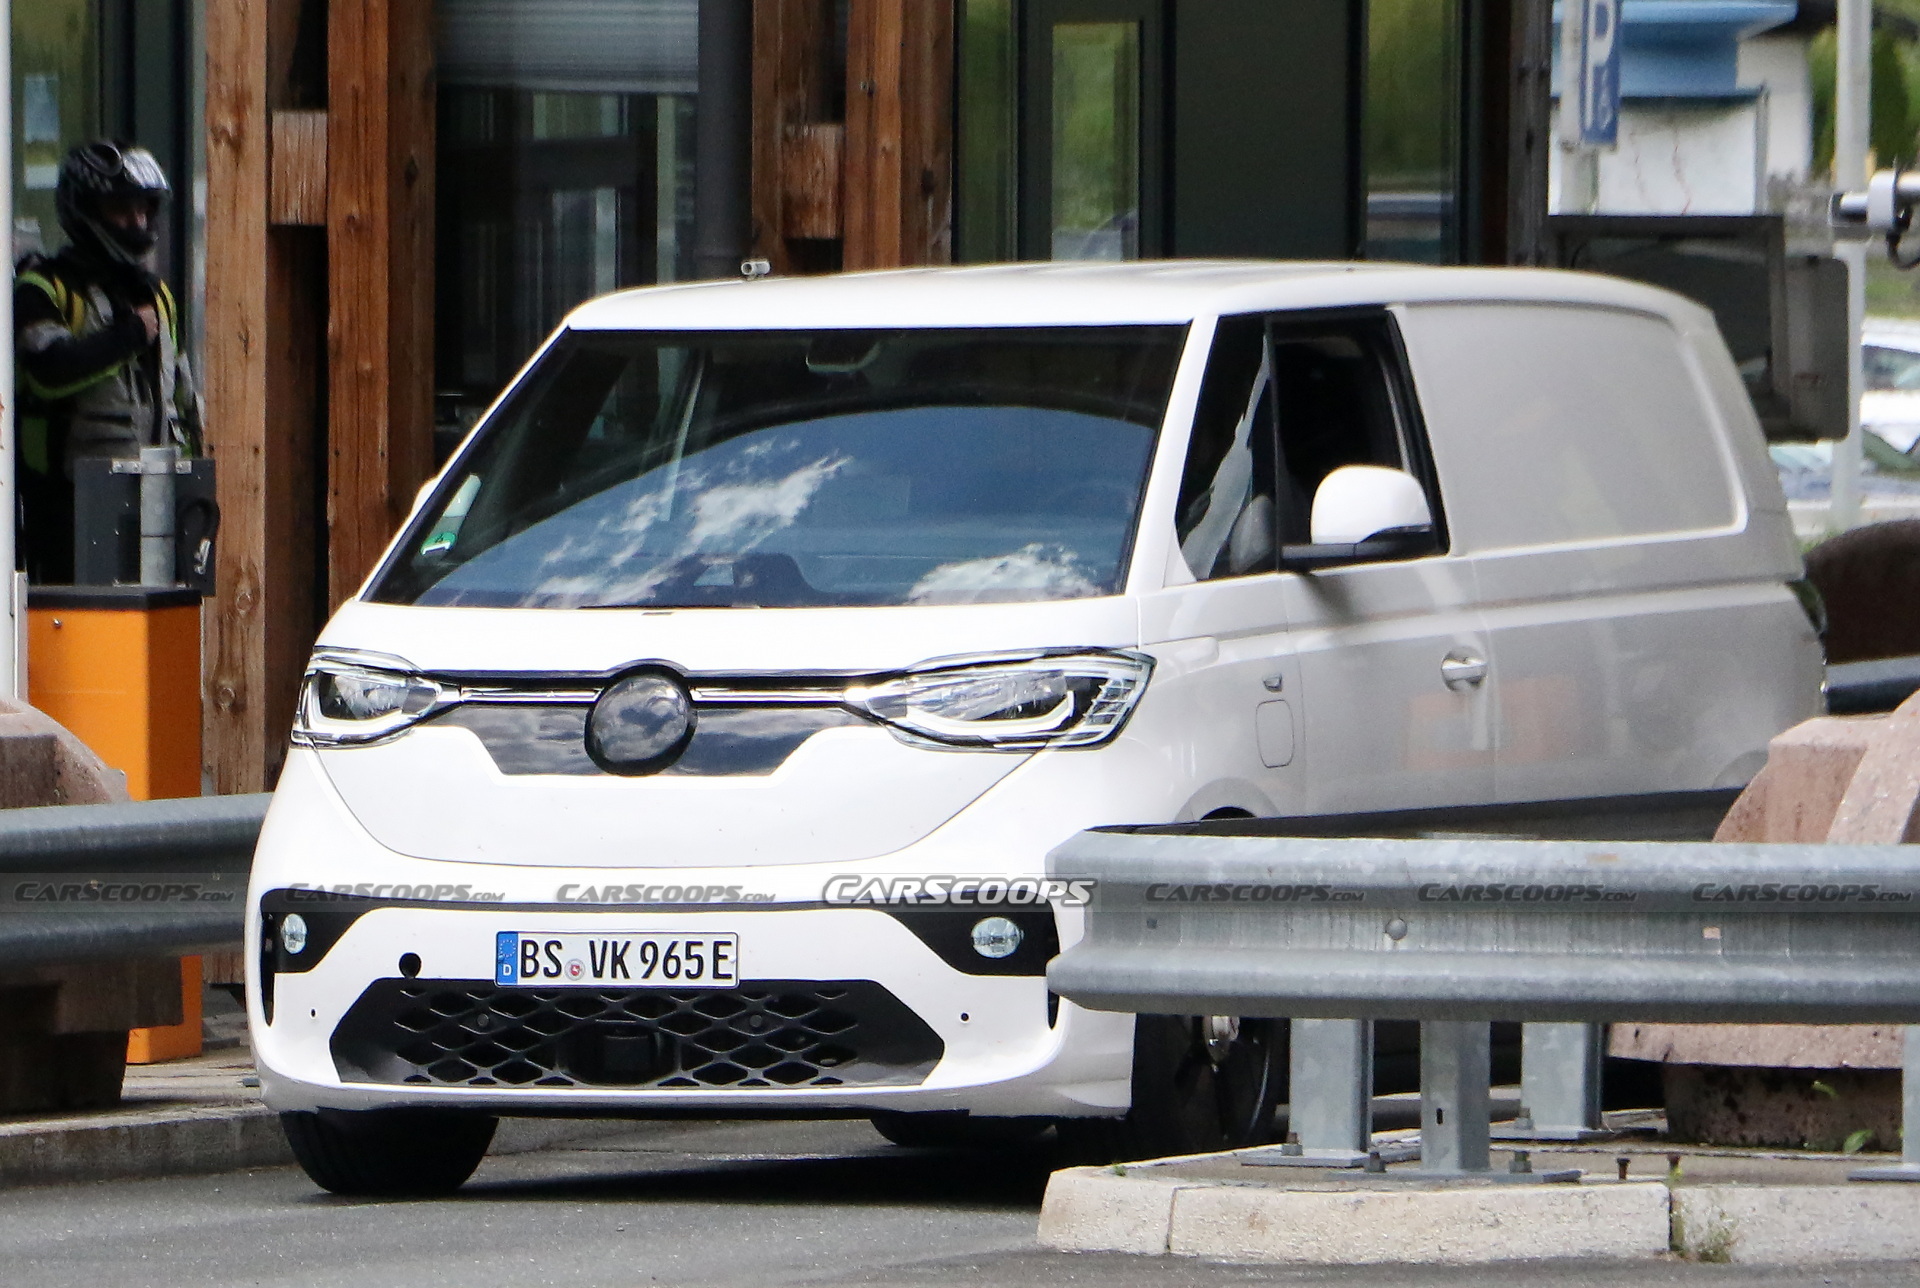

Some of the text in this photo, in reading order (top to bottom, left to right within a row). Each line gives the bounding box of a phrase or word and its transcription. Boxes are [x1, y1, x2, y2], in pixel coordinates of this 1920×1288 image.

[1585, 0, 1616, 131] P
[502, 963, 512, 976] D
[520, 939, 563, 979] BS
